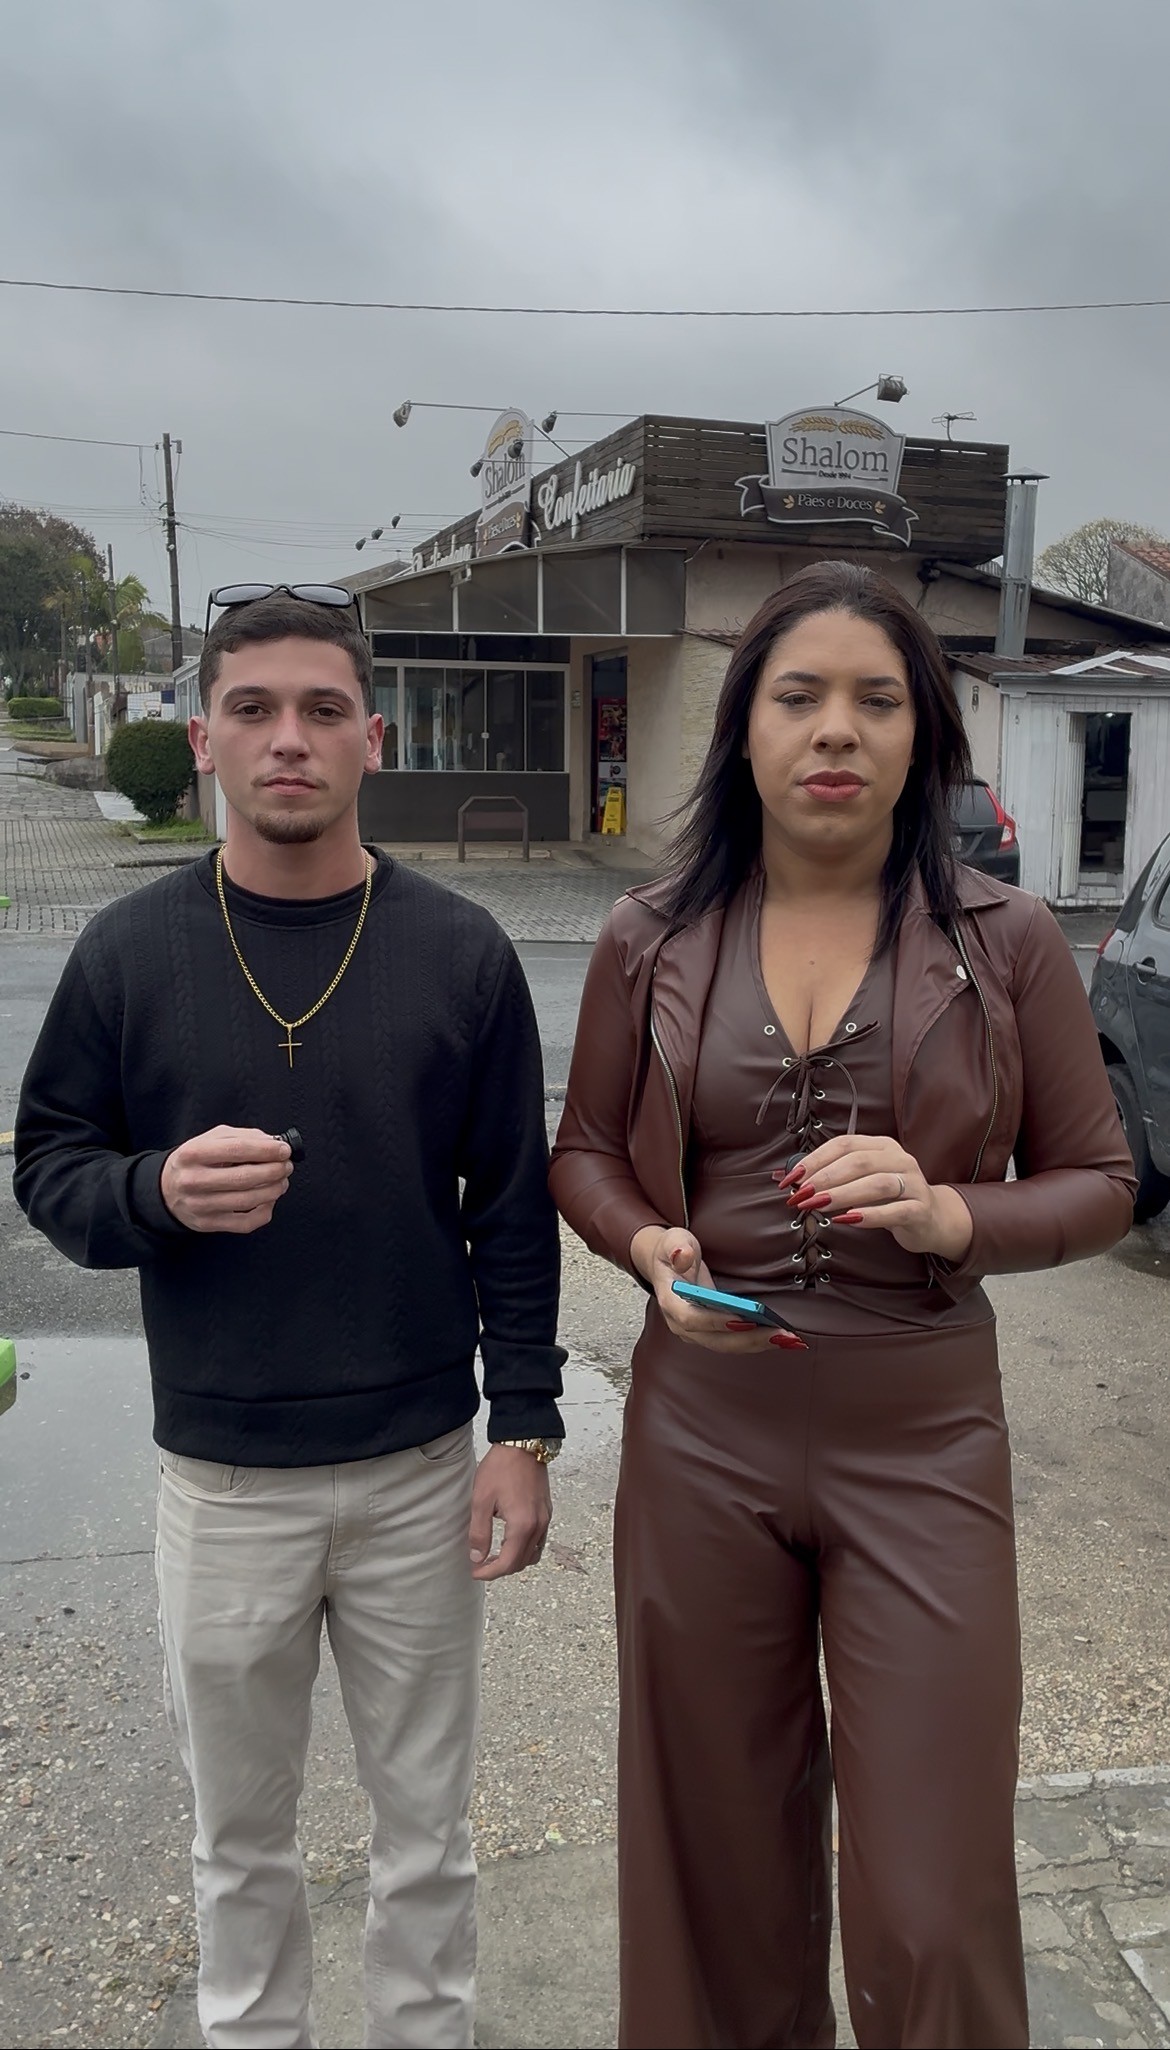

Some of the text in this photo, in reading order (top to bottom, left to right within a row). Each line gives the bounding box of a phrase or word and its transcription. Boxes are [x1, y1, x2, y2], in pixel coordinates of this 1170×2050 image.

[781, 437, 889, 472] Shalom
[538, 457, 637, 540] Confeitaria
[797, 493, 873, 510] Pães e Doces
